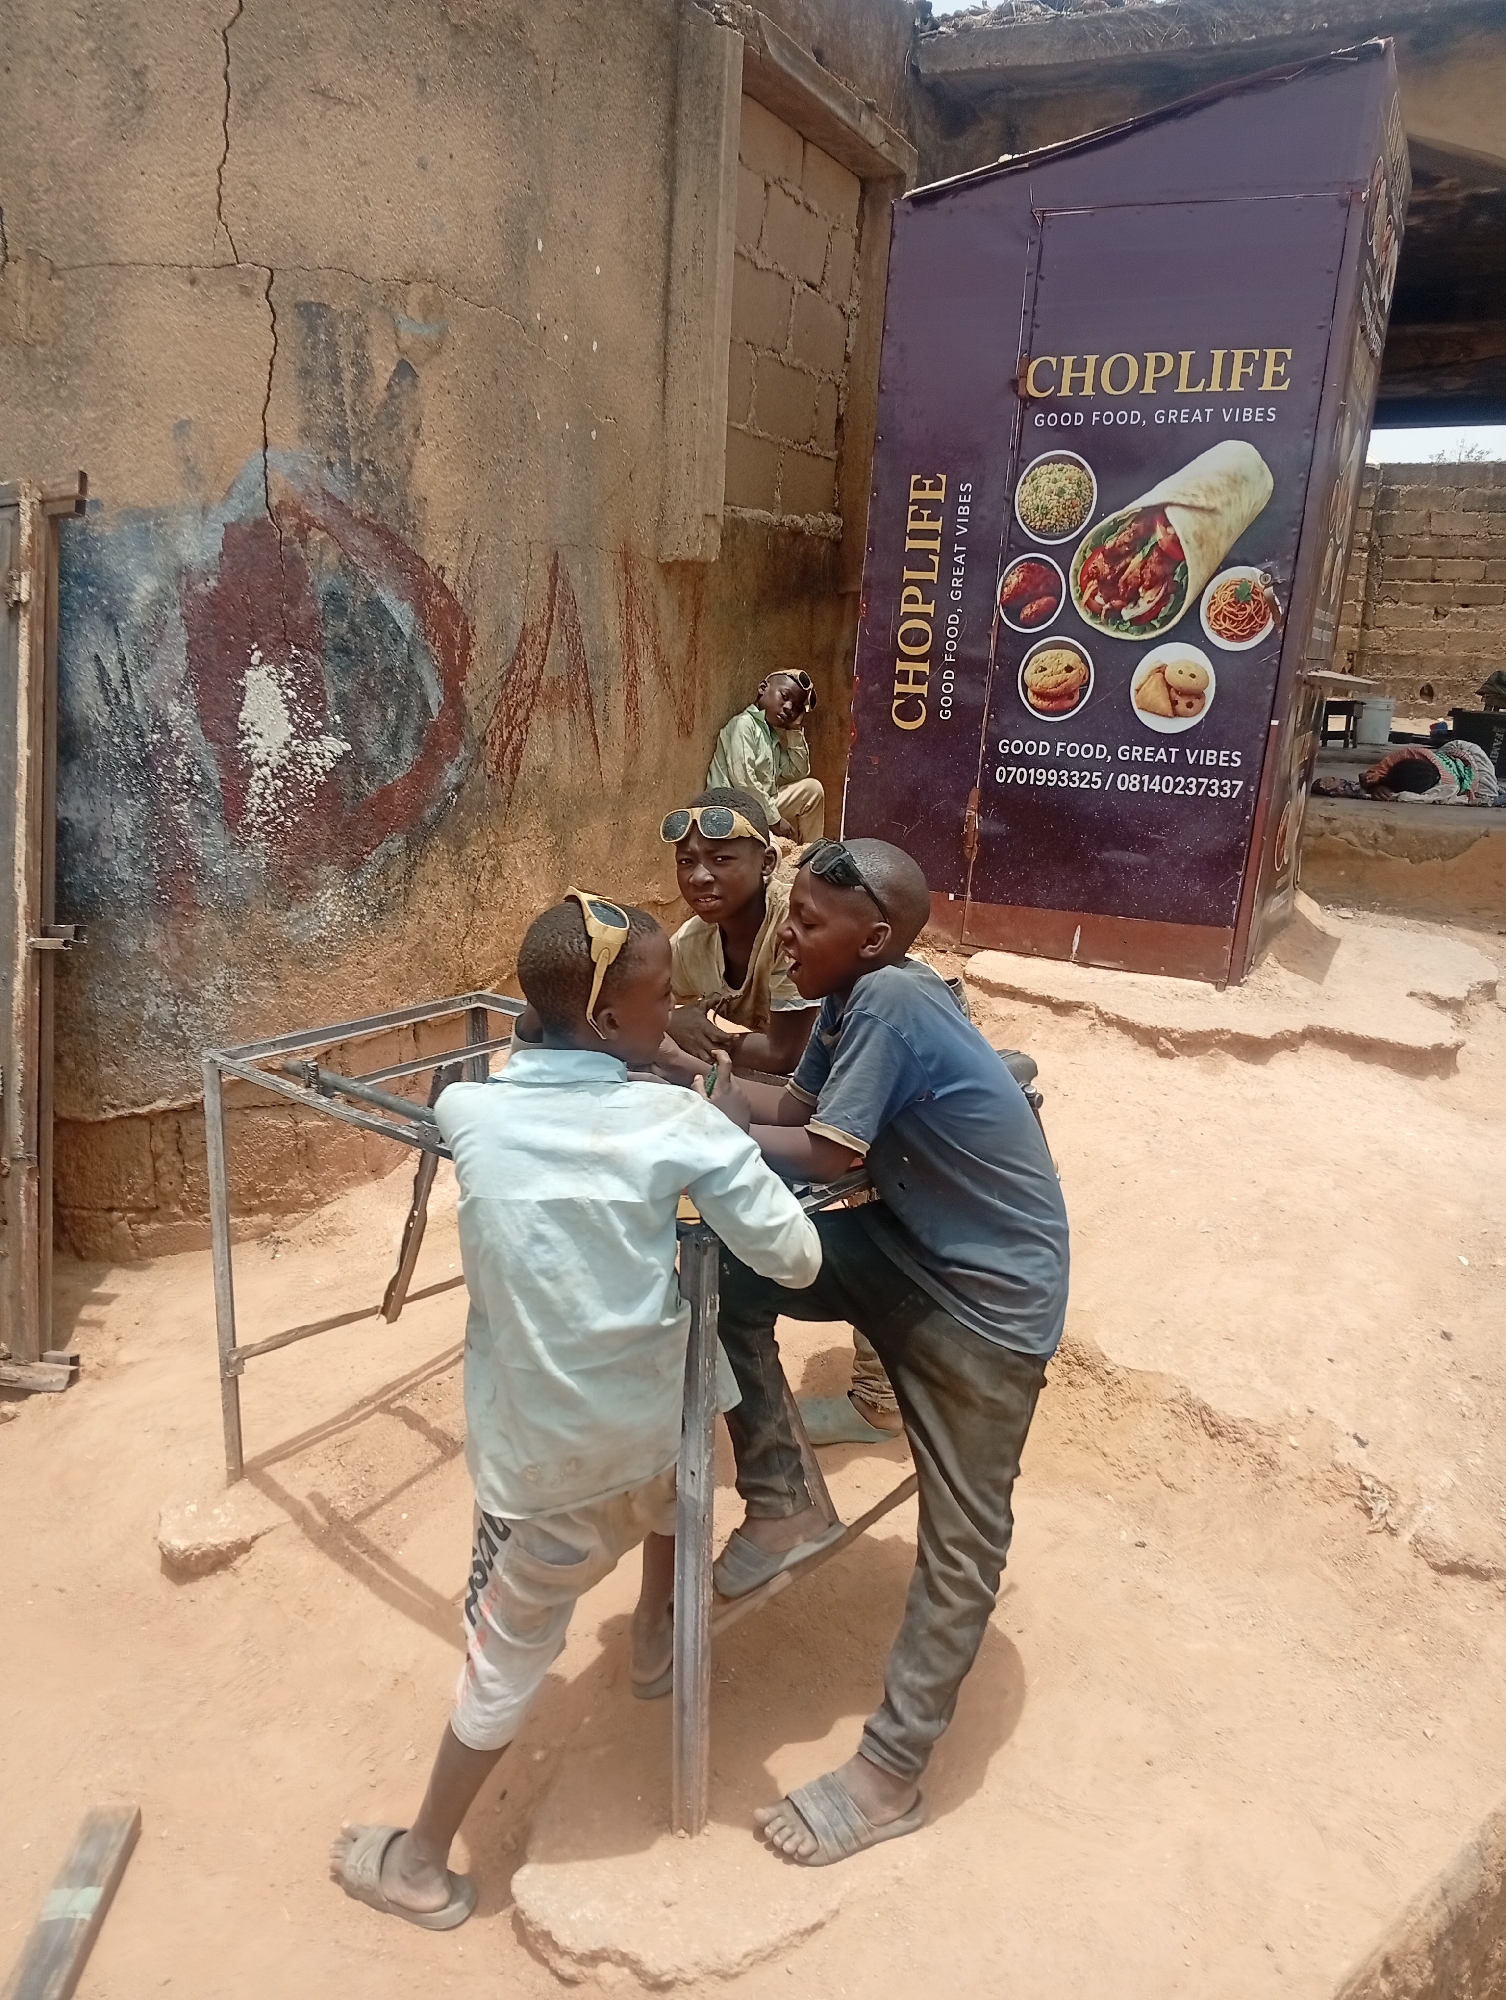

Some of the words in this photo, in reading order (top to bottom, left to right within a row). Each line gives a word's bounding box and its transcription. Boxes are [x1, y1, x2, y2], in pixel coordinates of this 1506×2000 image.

[1025, 348, 1293, 399] CHOPLIFE
[1034, 411, 1085, 427] GOOD
[1091, 410, 1147, 428] FOOD,
[1153, 407, 1214, 424] GREAT
[1221, 406, 1278, 423] VIBES
[955, 481, 973, 537] VIBES
[950, 543, 967, 601] GREAT
[891, 473, 948, 731] CHOPLIFE
[945, 605, 964, 662] FOOD,
[939, 669, 955, 721] GOOD
[998, 738, 1051, 757] GOOD
[1055, 741, 1112, 763] FOOD,
[1117, 744, 1180, 764] GREAT
[1185, 748, 1243, 768] VIBES
[995, 766, 1102, 790] 0701993325
[1116, 772, 1244, 799] 08140237337
